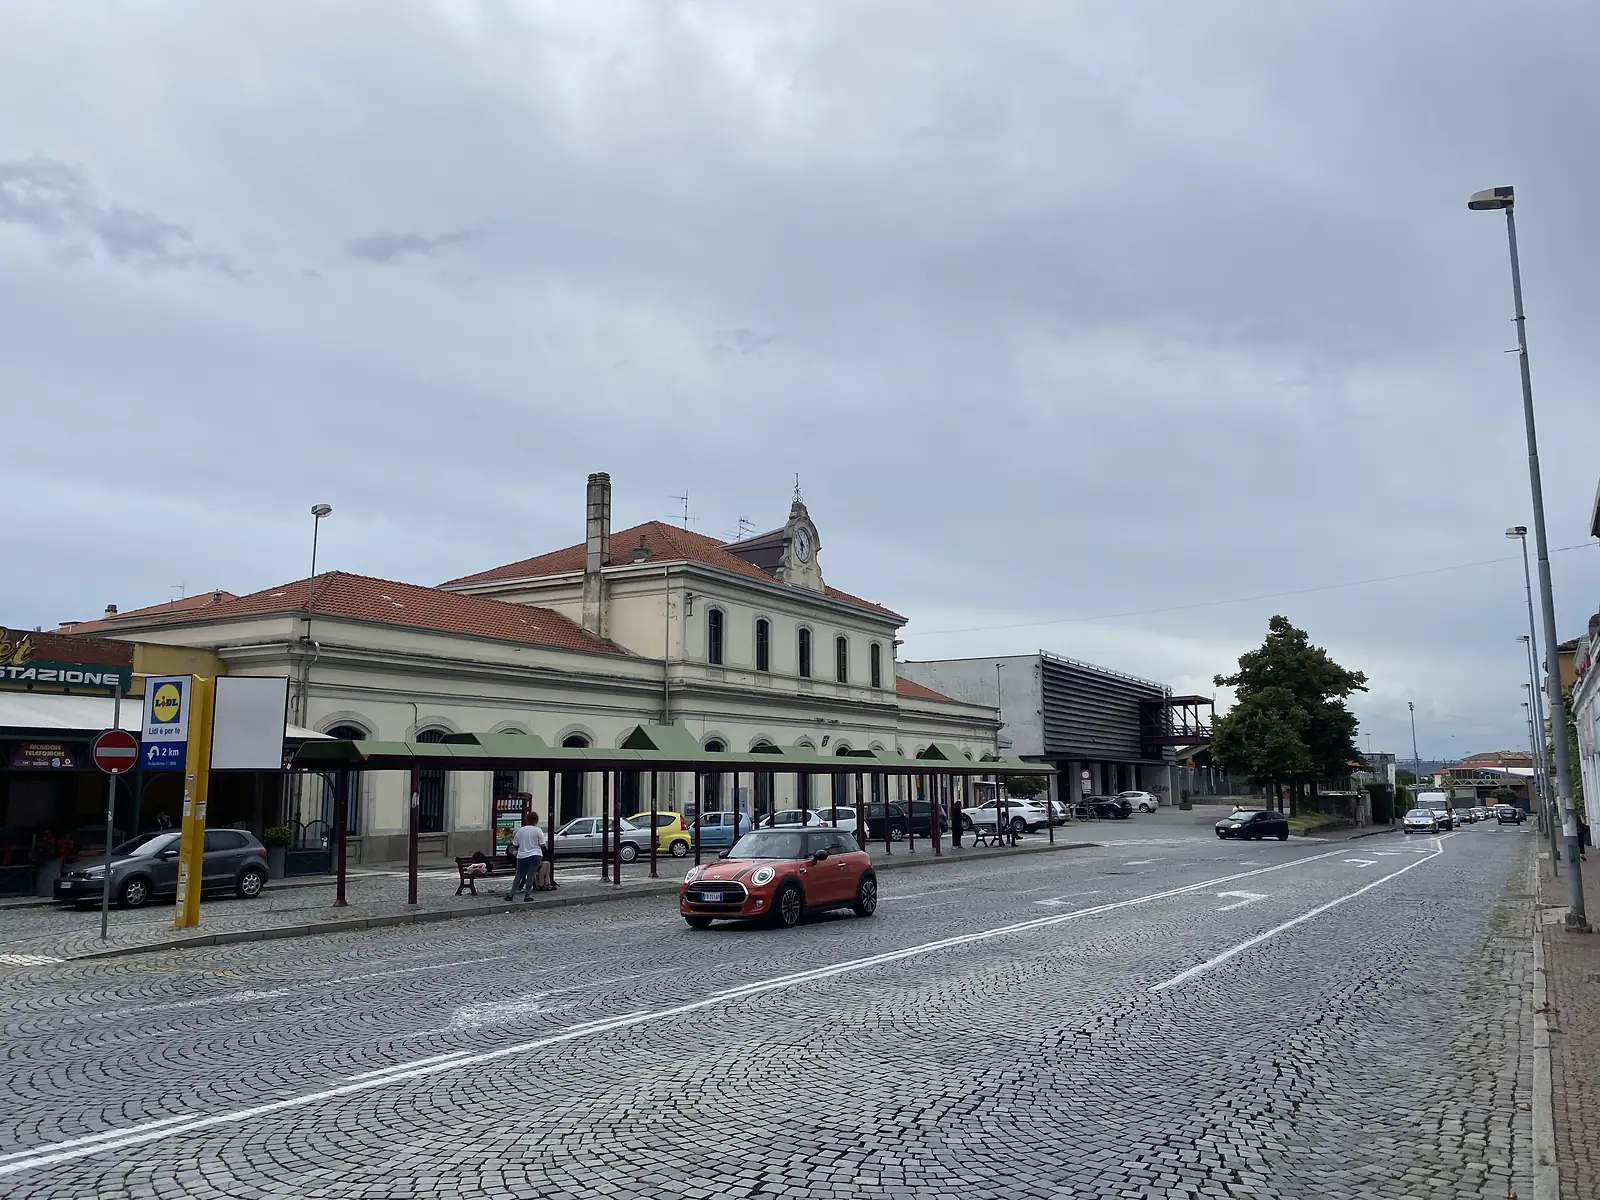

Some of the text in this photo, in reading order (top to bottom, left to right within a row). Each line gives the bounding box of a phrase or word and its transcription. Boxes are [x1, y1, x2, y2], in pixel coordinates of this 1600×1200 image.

[0, 628, 36, 665] et
[164, 728, 173, 736] per
[161, 748, 179, 757] 2 km
